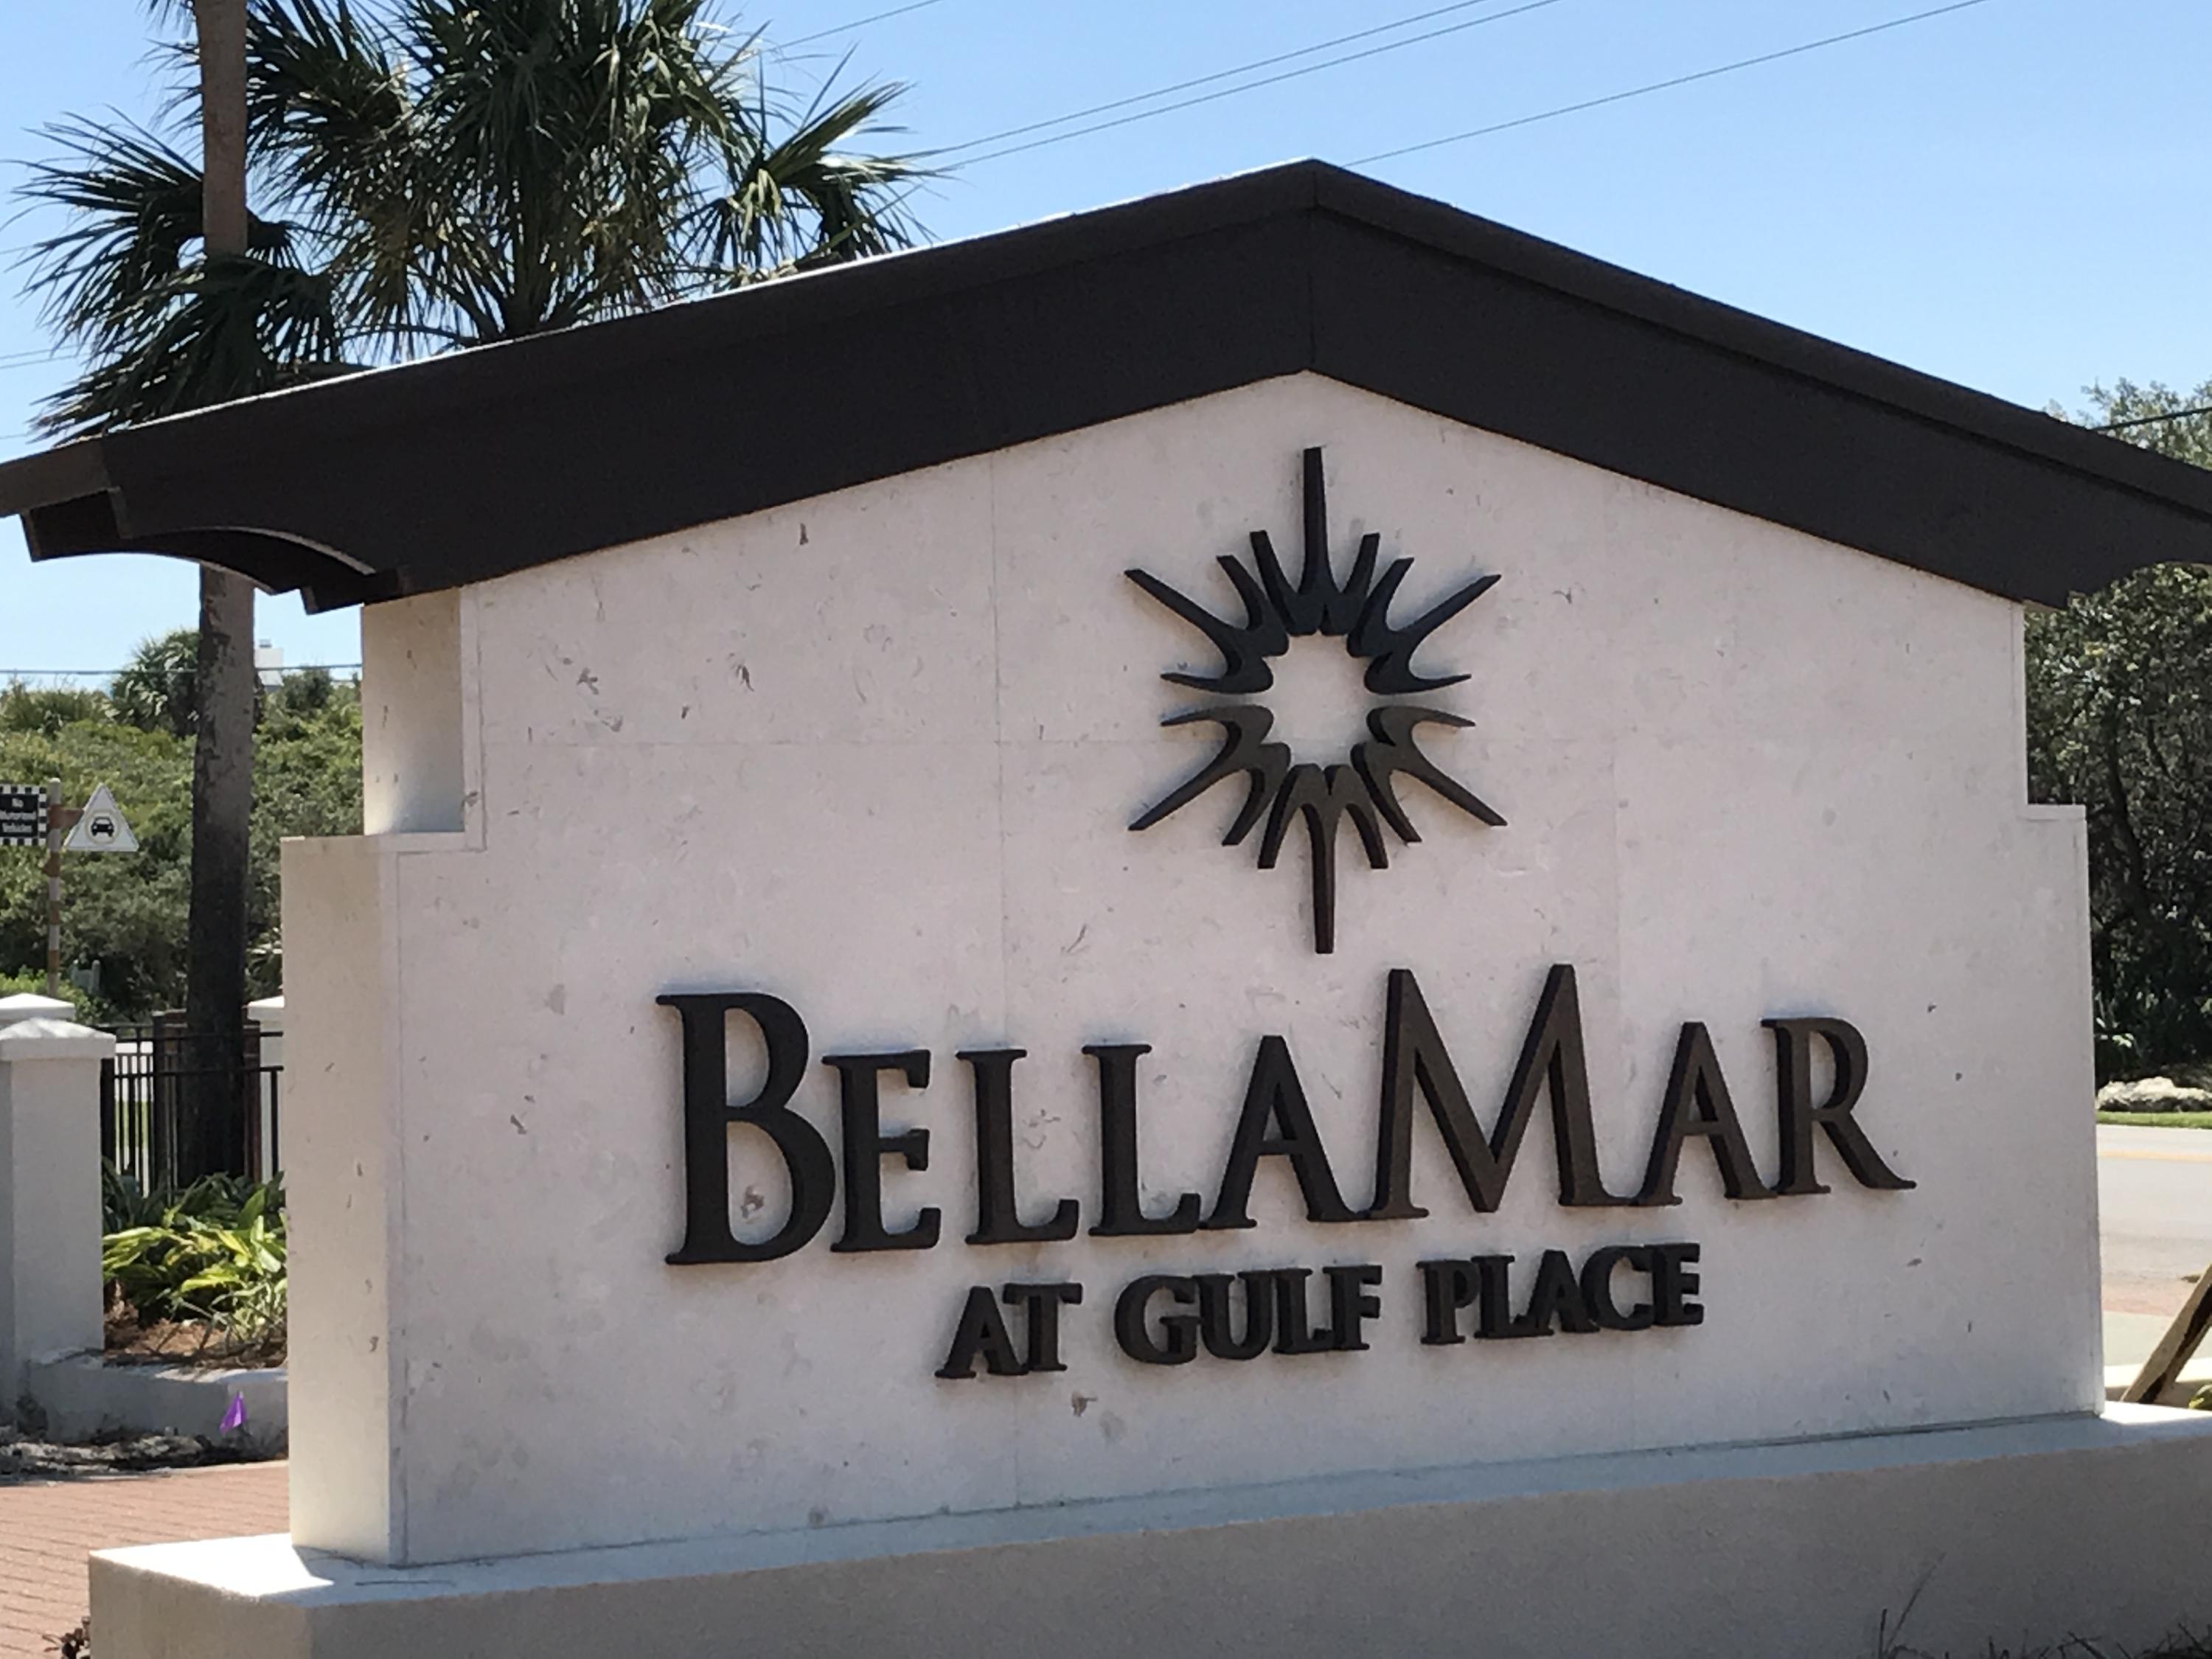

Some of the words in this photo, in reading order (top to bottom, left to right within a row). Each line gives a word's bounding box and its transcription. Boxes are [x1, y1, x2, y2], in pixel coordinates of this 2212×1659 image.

[935, 1281, 1083, 1380] AT
[1113, 1264, 1382, 1366] GULF
[1416, 1242, 1704, 1346] PLACE
